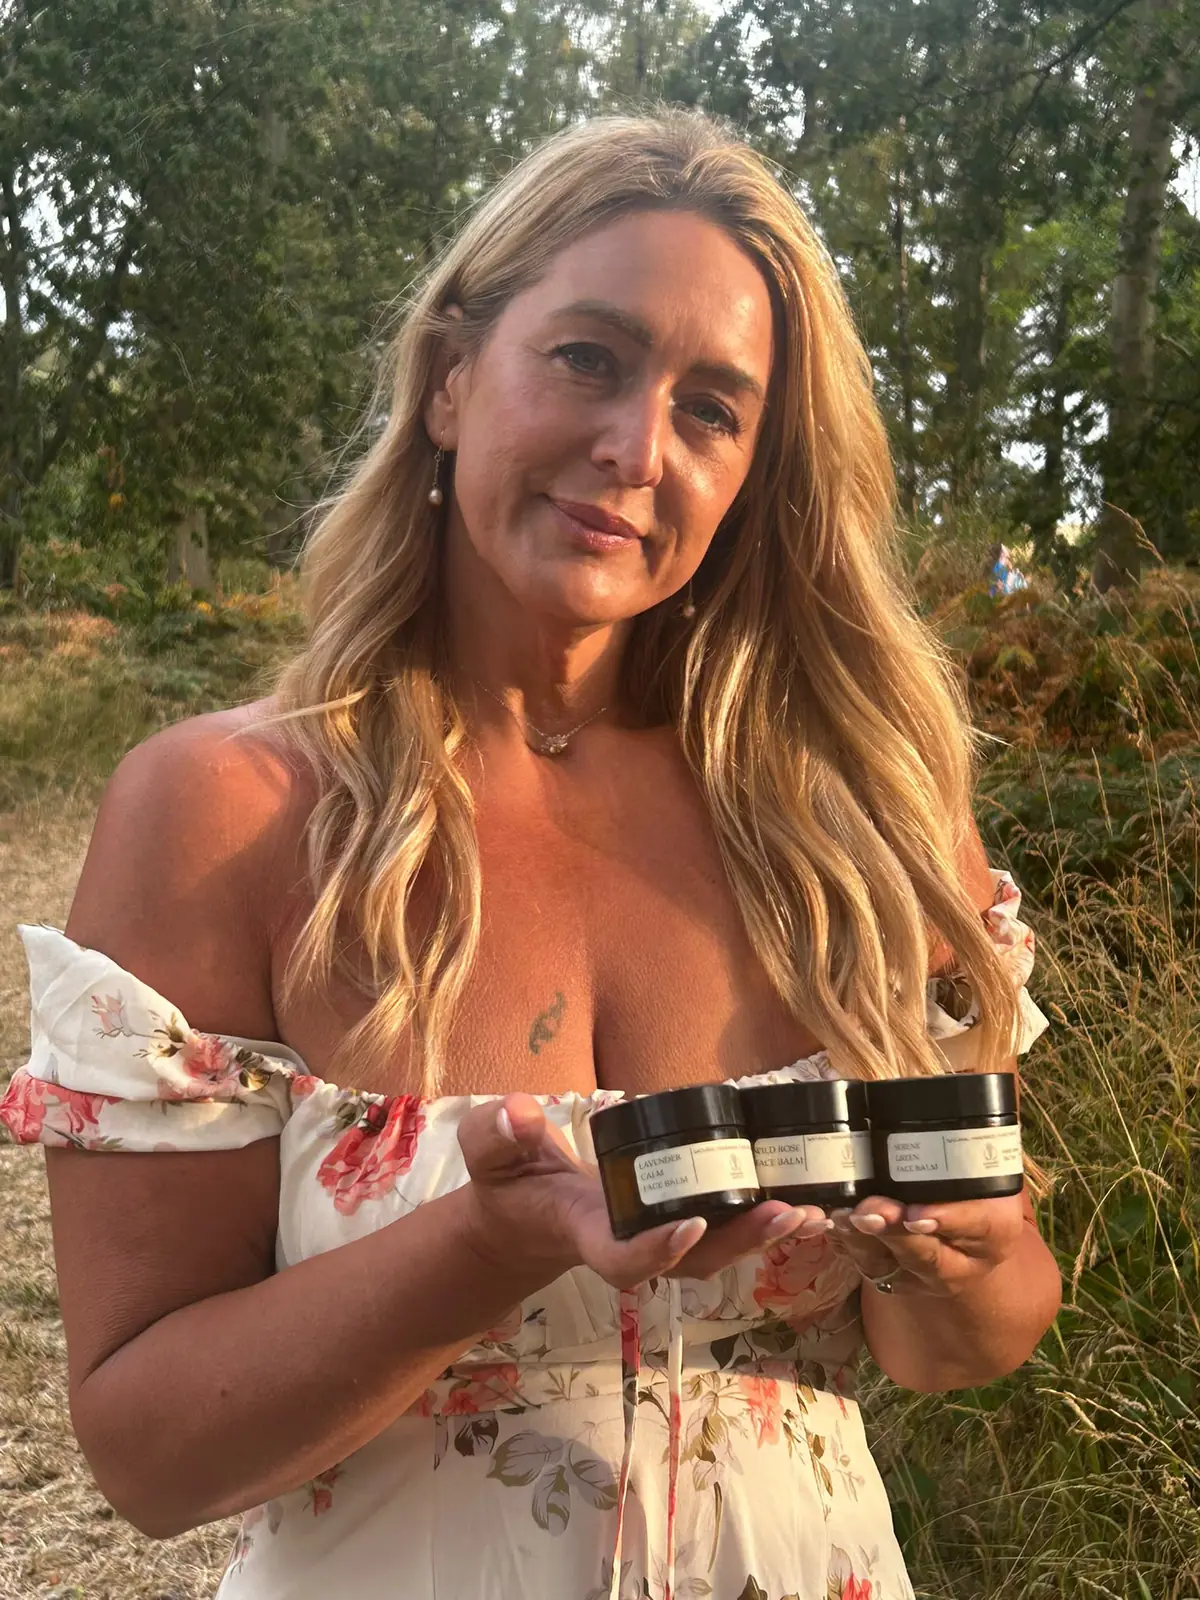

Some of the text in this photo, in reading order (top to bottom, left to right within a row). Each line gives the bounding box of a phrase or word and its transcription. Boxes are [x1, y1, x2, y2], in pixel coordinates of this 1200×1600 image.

[778, 1144, 801, 1153] ROSE
[639, 1153, 682, 1169] LAVENDER
[779, 1157, 804, 1166] BALM
[897, 1163, 939, 1172] FACE BALM
[641, 1169, 665, 1180] CALM
[643, 1176, 688, 1192] FACE BALM
